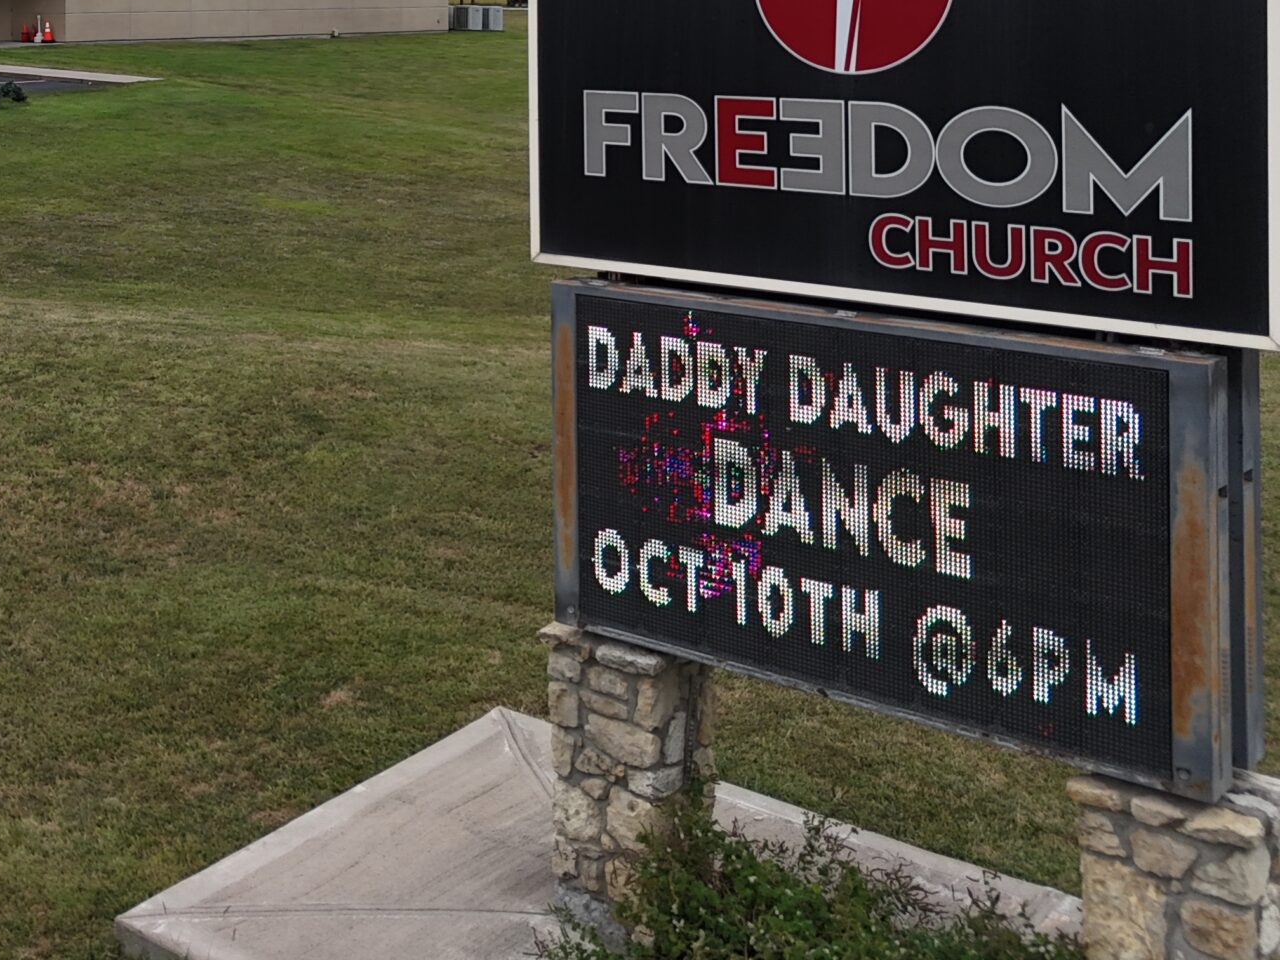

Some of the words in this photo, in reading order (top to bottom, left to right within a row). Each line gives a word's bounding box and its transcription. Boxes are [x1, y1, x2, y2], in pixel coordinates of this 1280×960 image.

[583, 89, 1193, 222] FREEDOM
[869, 213, 1193, 298] CHURCH
[588, 326, 768, 415] DADDY
[788, 353, 1145, 480] DAUGHTER
[710, 438, 972, 580] DANCE
[592, 528, 704, 614] OCT
[731, 559, 880, 660] 10TH
[913, 604, 1137, 726] @6PM
